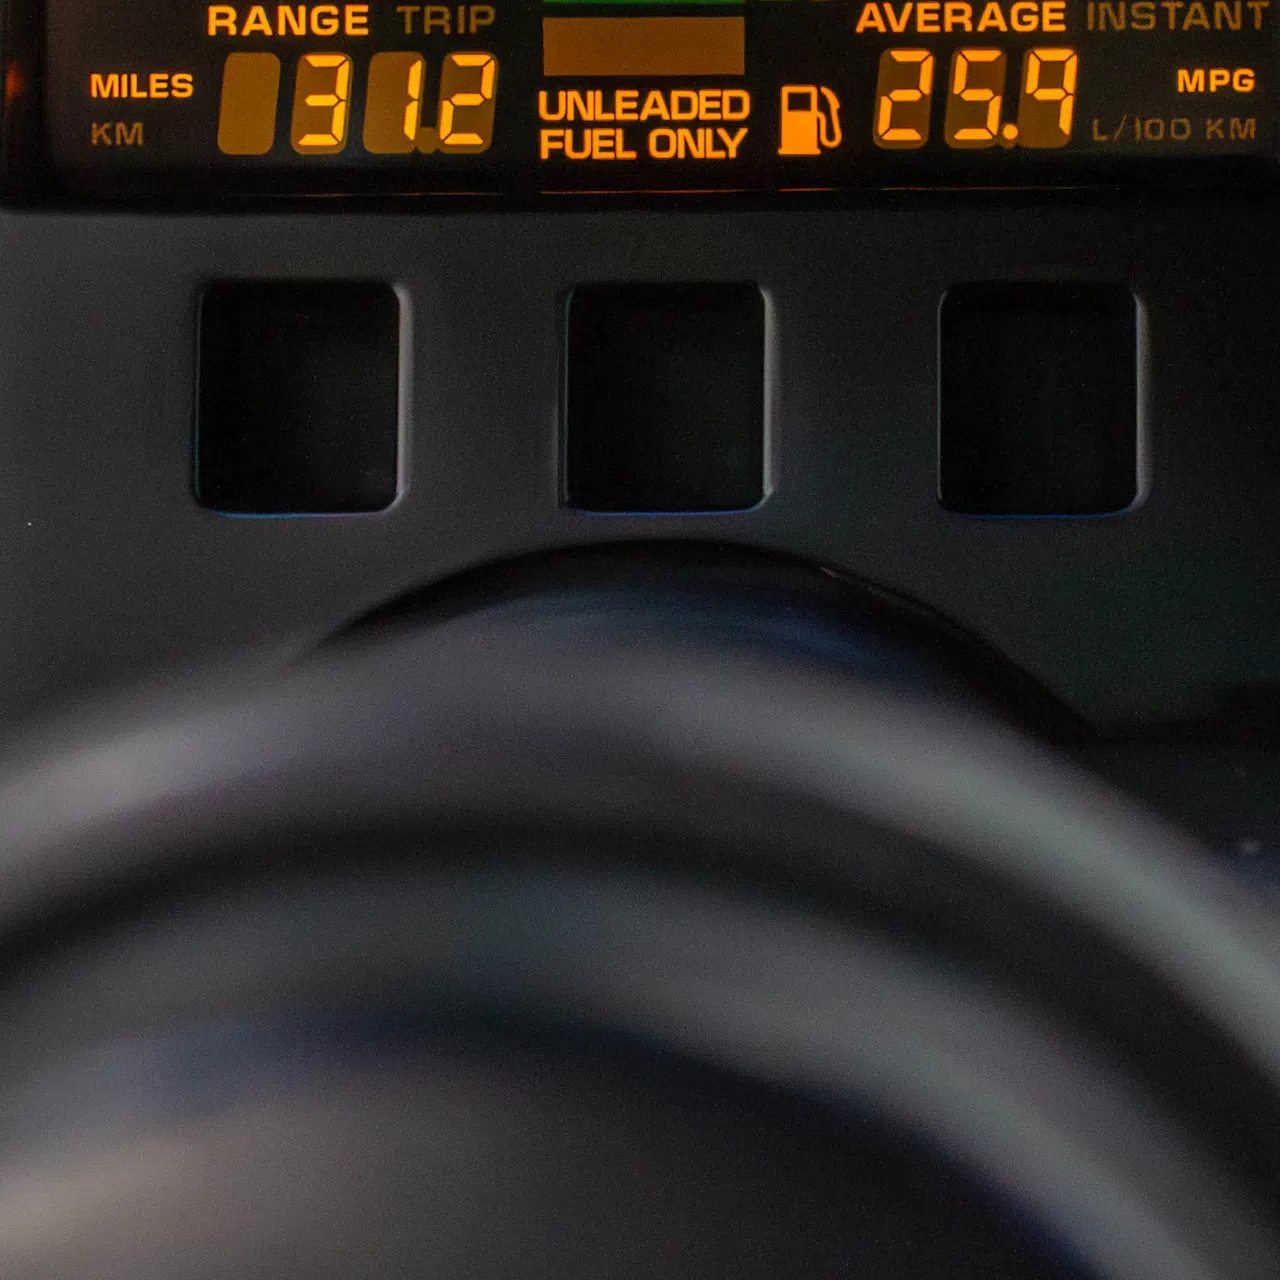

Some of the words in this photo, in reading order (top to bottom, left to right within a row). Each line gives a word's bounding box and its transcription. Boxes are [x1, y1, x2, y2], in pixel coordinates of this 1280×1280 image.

[207, 5, 370, 36] RANGE
[396, 5, 496, 35] TRIP
[856, 1, 1067, 34] AVERAGE
[1087, 0, 1270, 32] INSTANT
[90, 73, 194, 99] MILES
[878, 49, 1078, 141] 25.9
[1177, 68, 1255, 92] MPG
[297, 55, 495, 145] 312
[538, 90, 750, 121] UNLEADED
[91, 123, 144, 146] KM
[540, 128, 637, 159] FUEL
[649, 128, 748, 159] ONLY
[1091, 117, 1192, 143] L/100
[1206, 118, 1256, 140] KM
